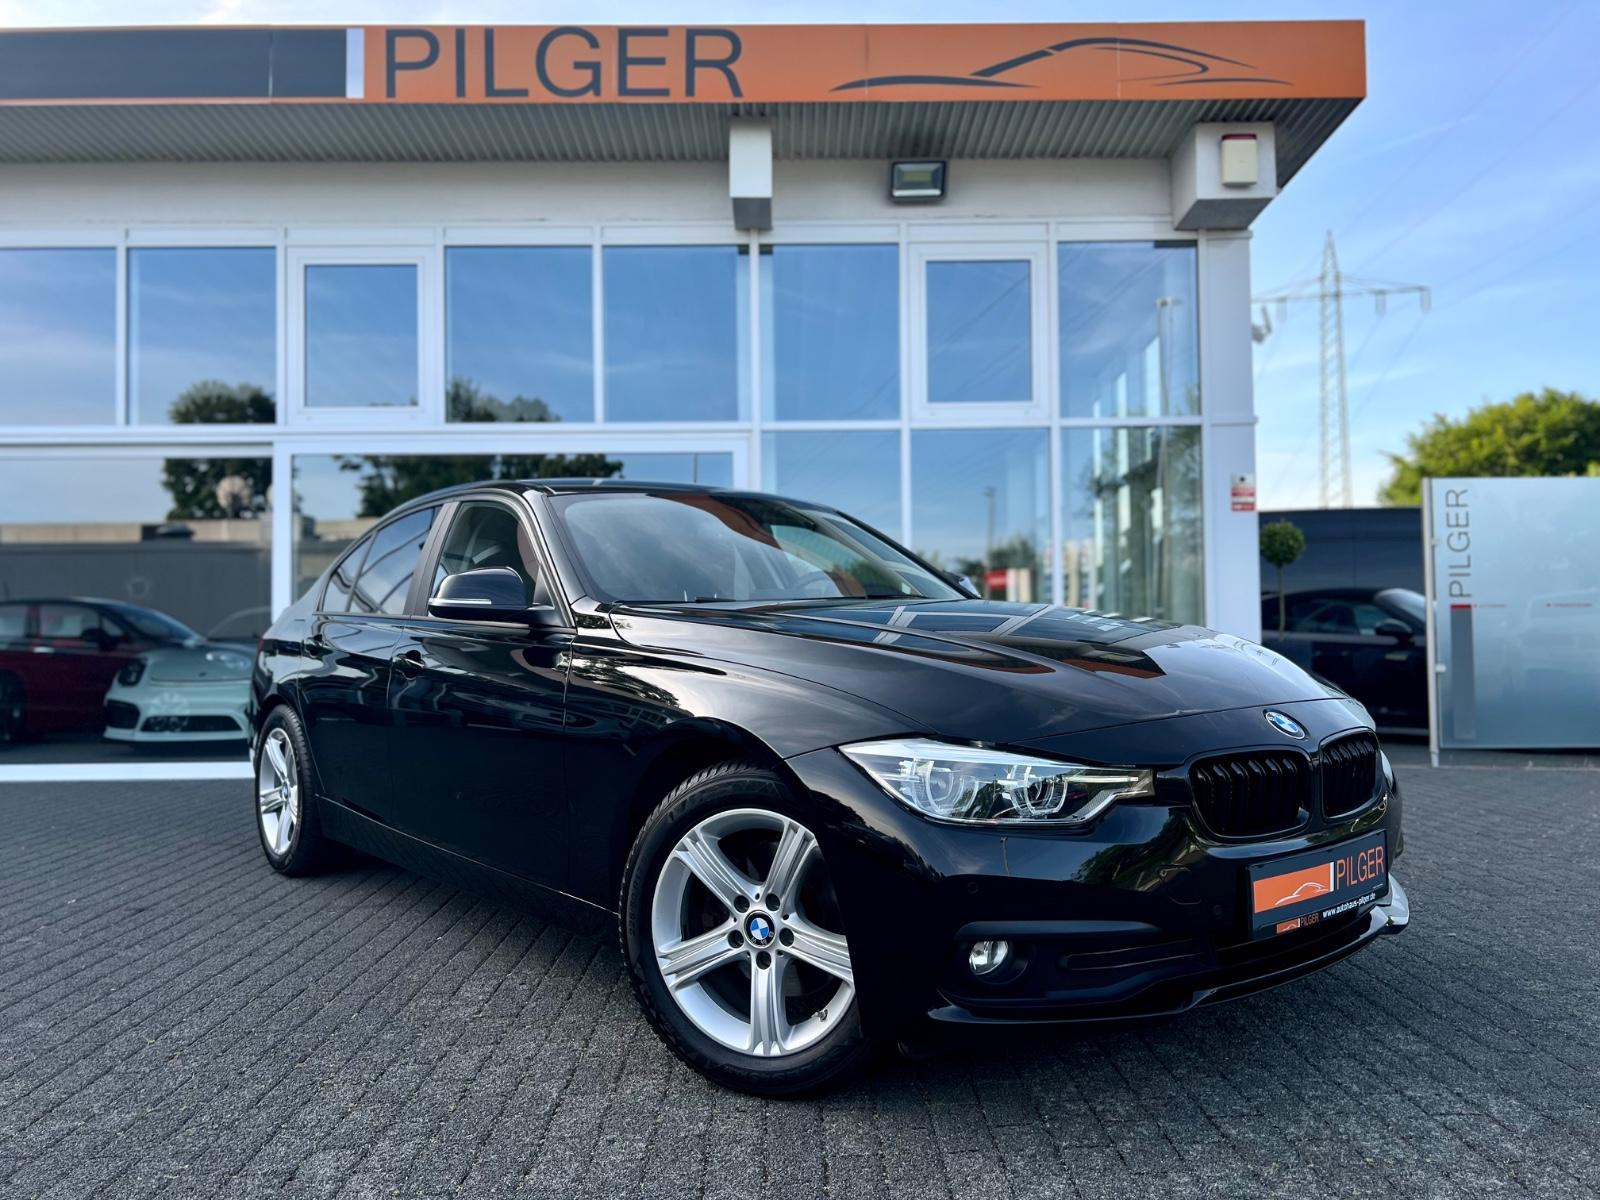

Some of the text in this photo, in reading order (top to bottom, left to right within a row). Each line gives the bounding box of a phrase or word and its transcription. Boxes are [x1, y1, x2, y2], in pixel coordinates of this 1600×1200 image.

[385, 26, 743, 99] PILGER
[1446, 489, 1471, 598] PILGER
[1336, 846, 1384, 890] PILGER
[1300, 913, 1319, 927] PILGER
[1323, 893, 1376, 918] www.autohaus-pilger.de
